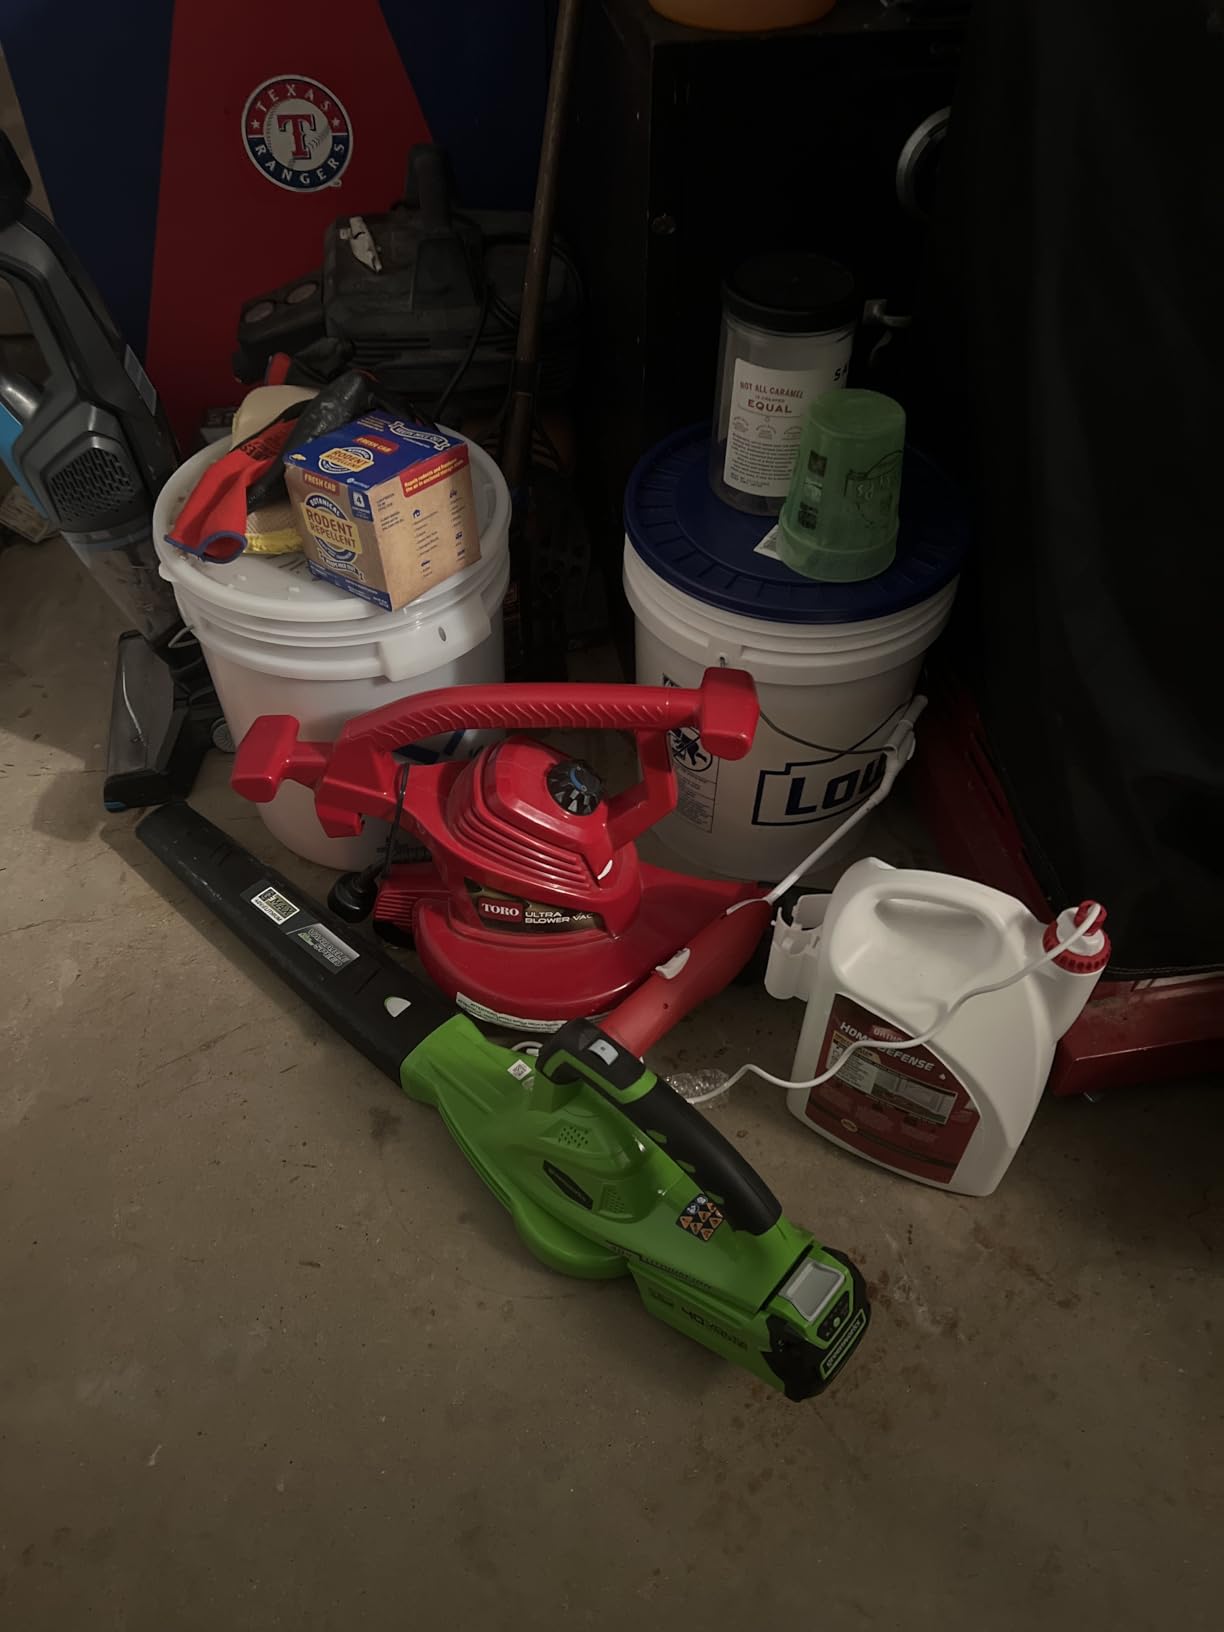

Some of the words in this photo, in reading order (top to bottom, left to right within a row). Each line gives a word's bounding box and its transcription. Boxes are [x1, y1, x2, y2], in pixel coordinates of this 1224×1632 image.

[256, 84, 331, 112] TEXAS
[255, 143, 345, 184] RANGERS
[740, 381, 753, 391] NOT
[754, 384, 768, 395] ALL
[769, 387, 804, 400] CARAMEL
[747, 399, 792, 414] EQUAL
[331, 450, 369, 468] RODENT
[304, 473, 323, 488] FRESH
[323, 481, 338, 493] CAB
[310, 495, 342, 517] BOTANICAL
[356, 495, 362, 505] 4
[306, 509, 353, 537] RODENT
[310, 524, 356, 549] REPELLENT
[481, 902, 520, 917] TORO
[524, 916, 571, 925] BLOWER
[572, 912, 594, 921] VAC
